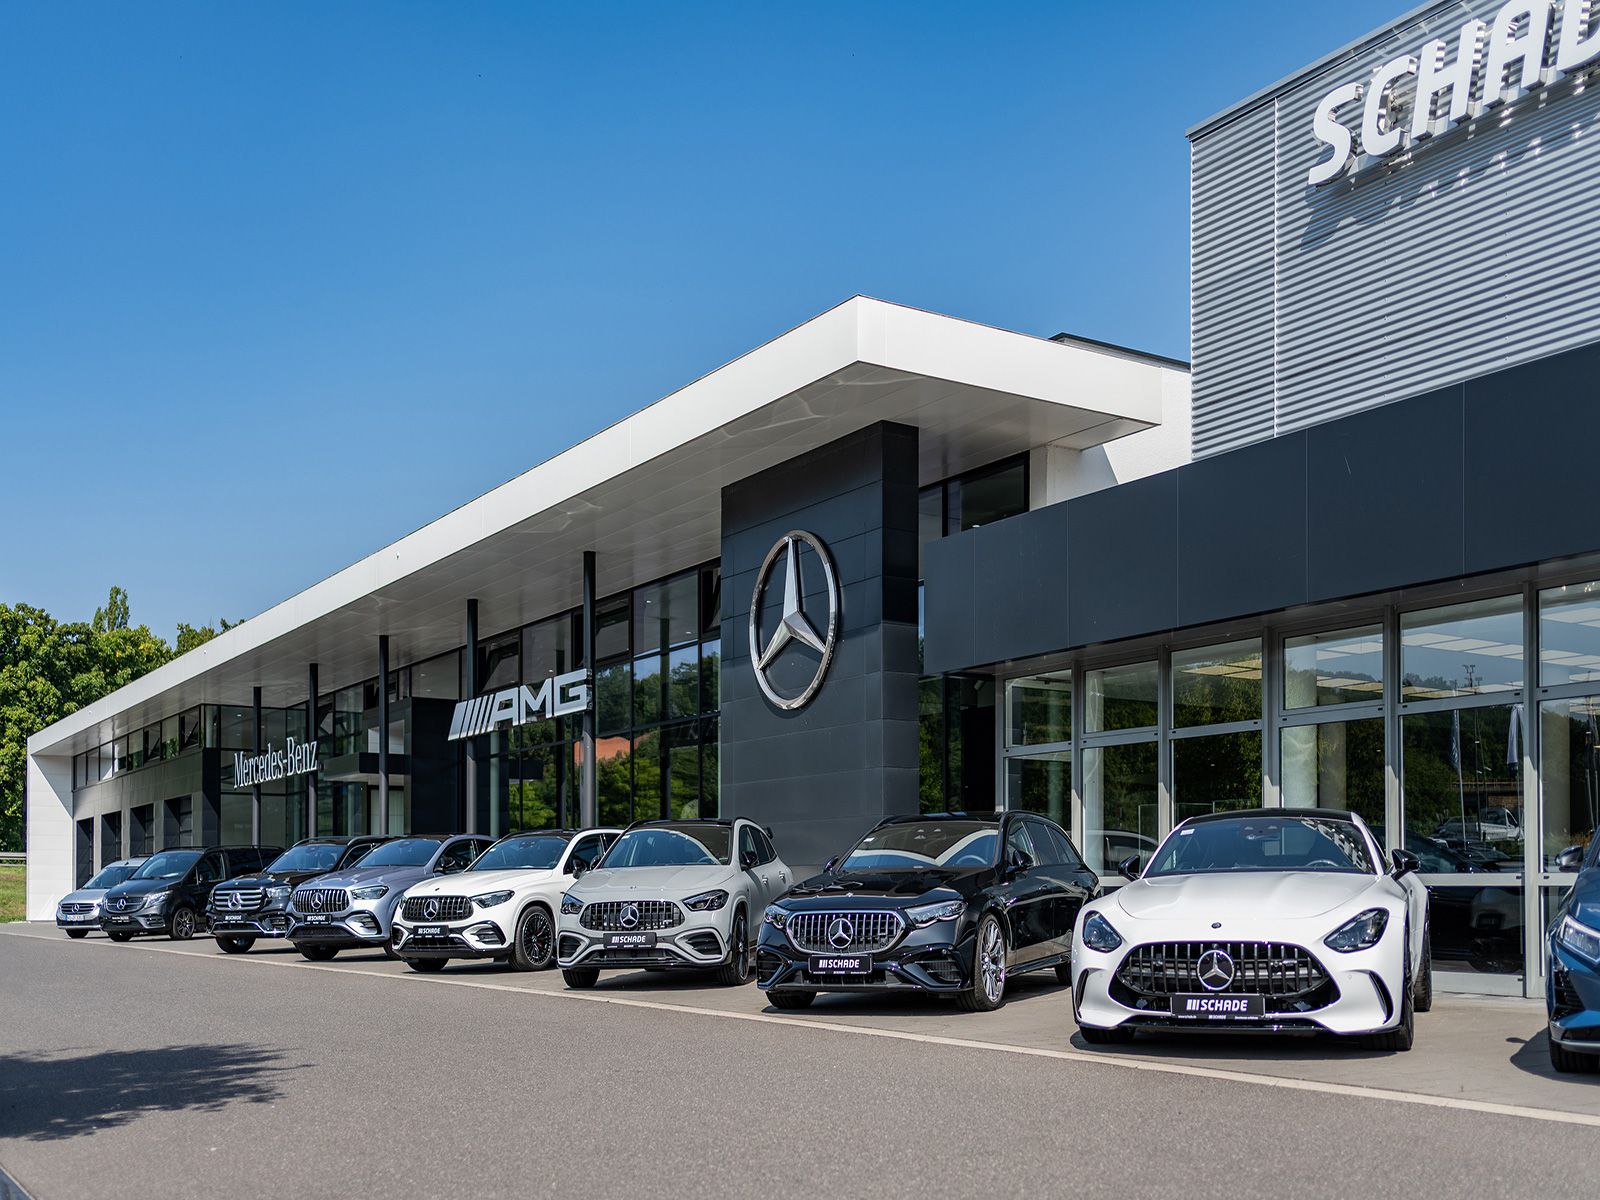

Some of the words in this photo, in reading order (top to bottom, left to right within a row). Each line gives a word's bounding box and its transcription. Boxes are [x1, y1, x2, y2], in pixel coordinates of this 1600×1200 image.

[488, 668, 588, 732] AMG
[233, 736, 317, 789] Mercedes-Benz
[619, 935, 646, 943] SCHADE
[827, 959, 860, 968] SCHADE
[1200, 999, 1249, 1012] SCHADE
